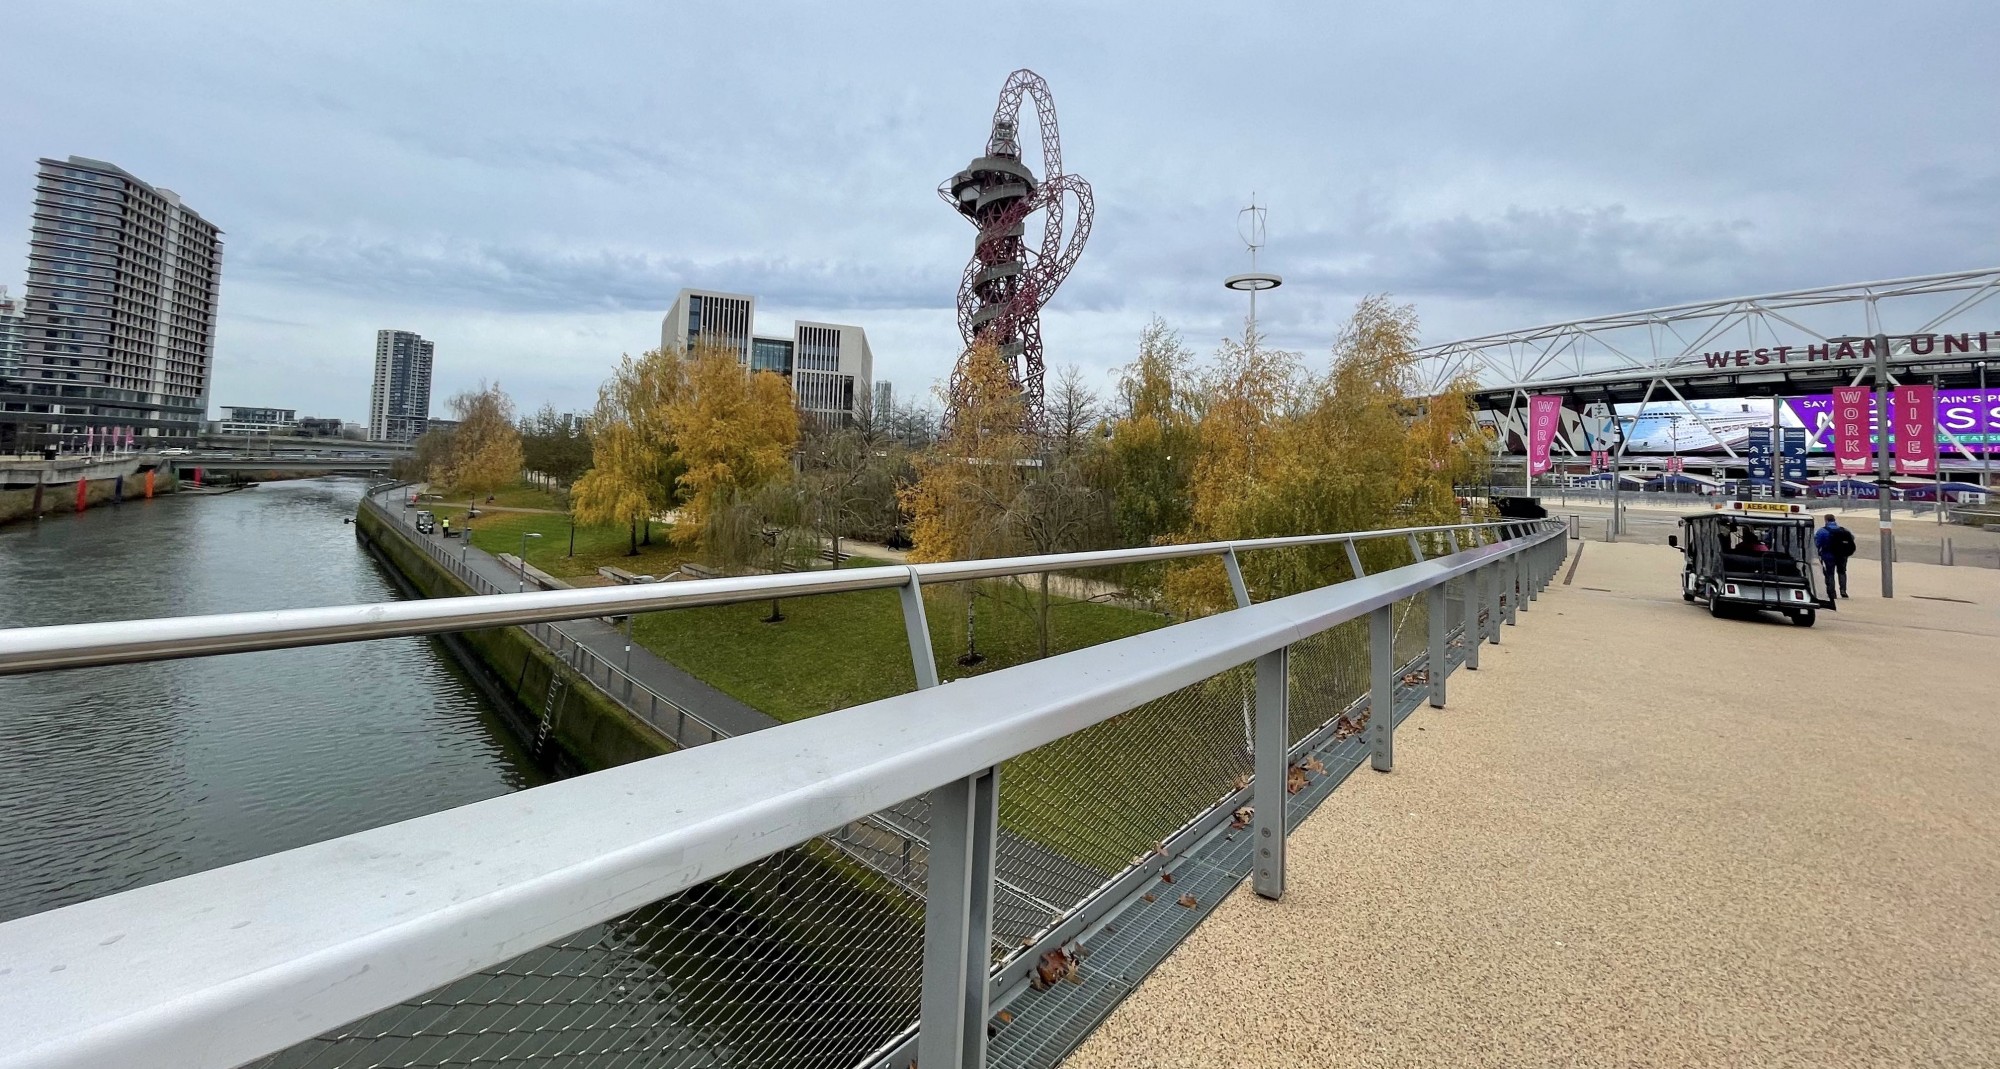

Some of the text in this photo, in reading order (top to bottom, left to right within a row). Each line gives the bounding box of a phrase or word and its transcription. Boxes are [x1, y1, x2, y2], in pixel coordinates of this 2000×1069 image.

[1704, 346, 1792, 368] WEST
[1910, 331, 2000, 355] UNI
[1536, 401, 1553, 456] WORK
[1840, 391, 1861, 452] WORK
[1906, 390, 1922, 454] LIVE
